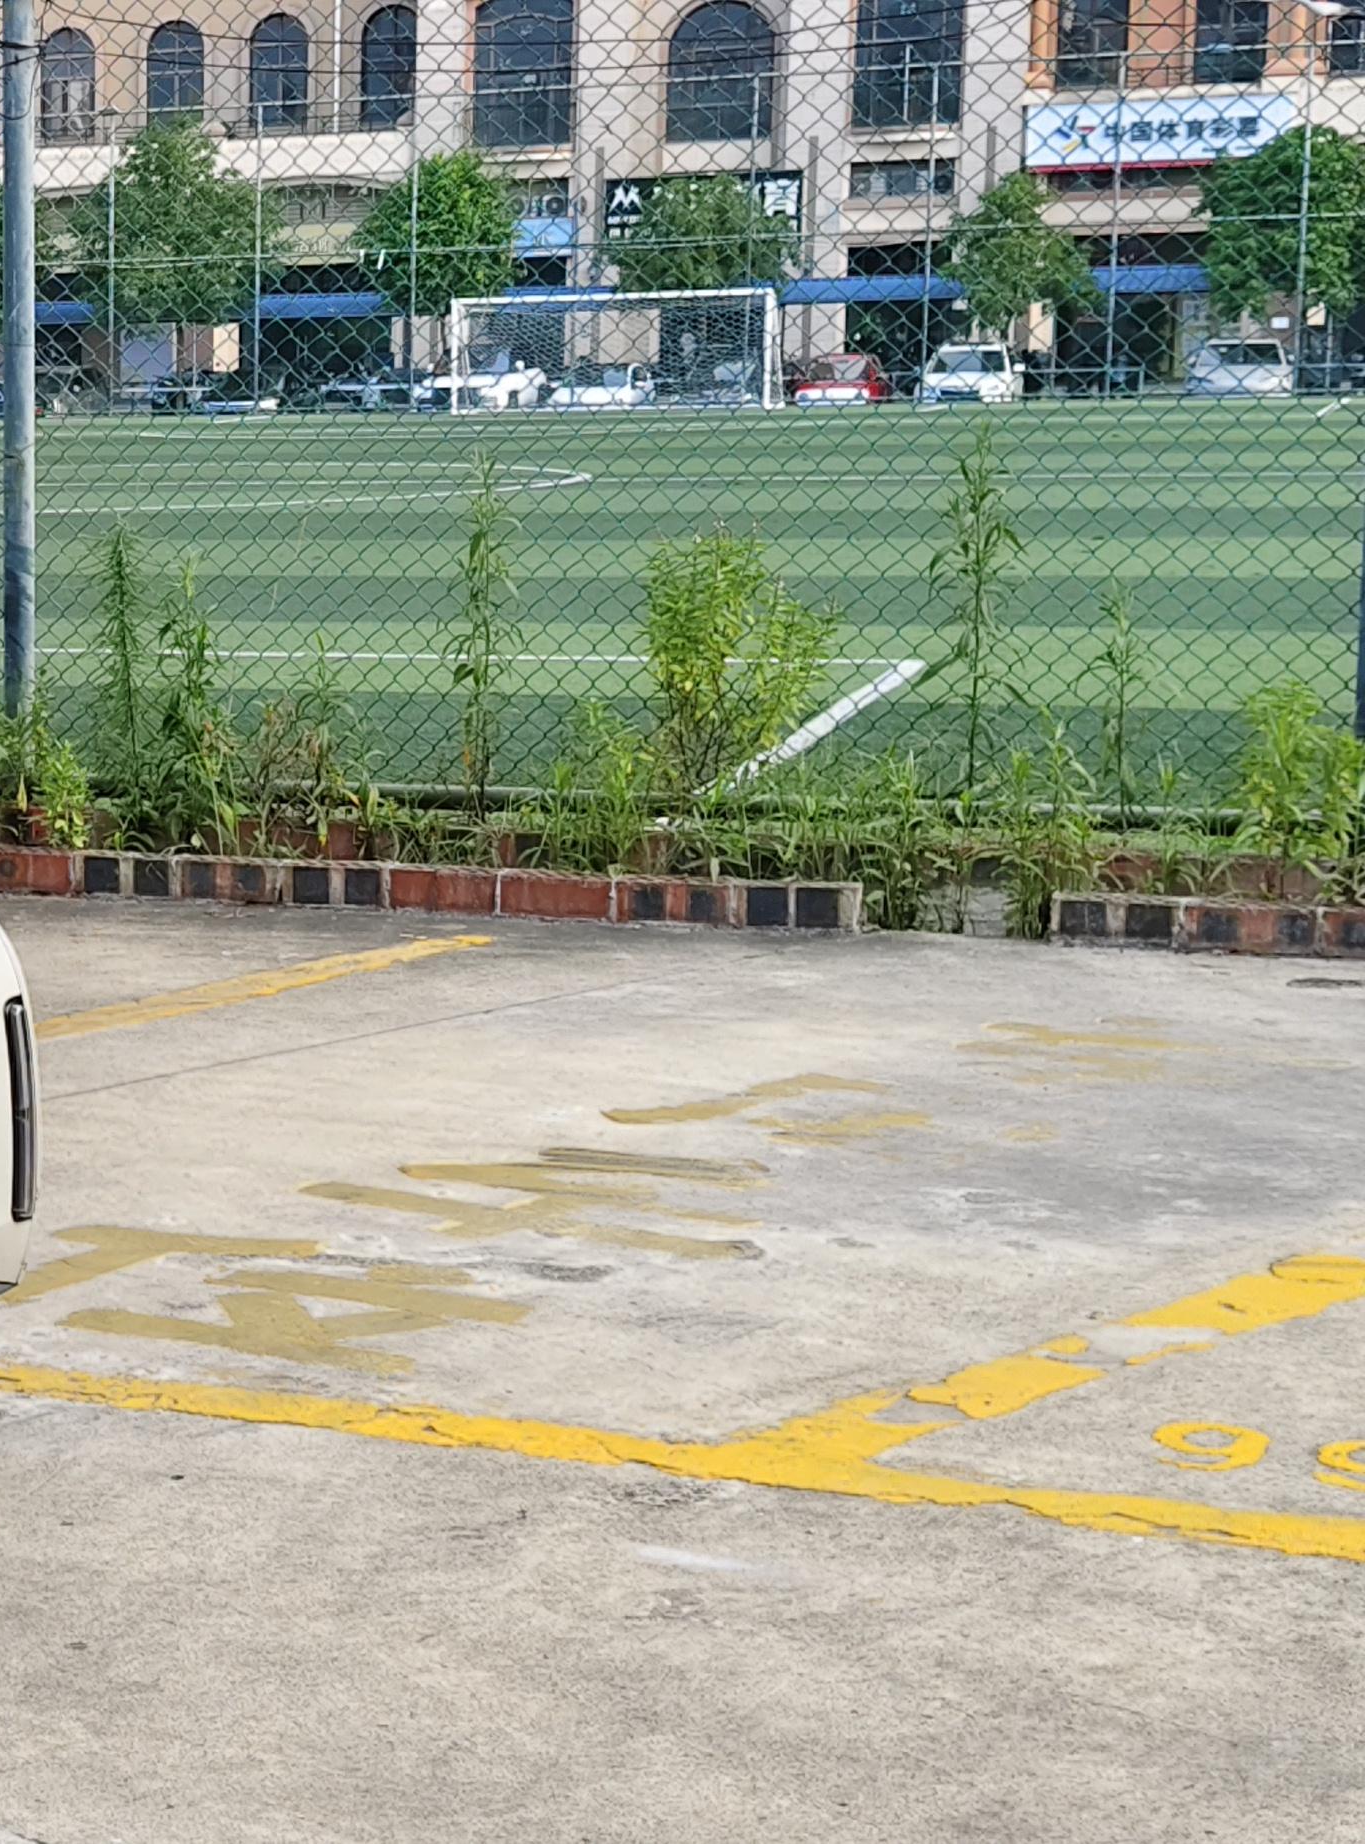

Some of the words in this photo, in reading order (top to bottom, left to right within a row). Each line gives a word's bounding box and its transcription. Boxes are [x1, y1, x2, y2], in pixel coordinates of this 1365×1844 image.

[1103, 116, 1261, 142] 中国体育彩票
